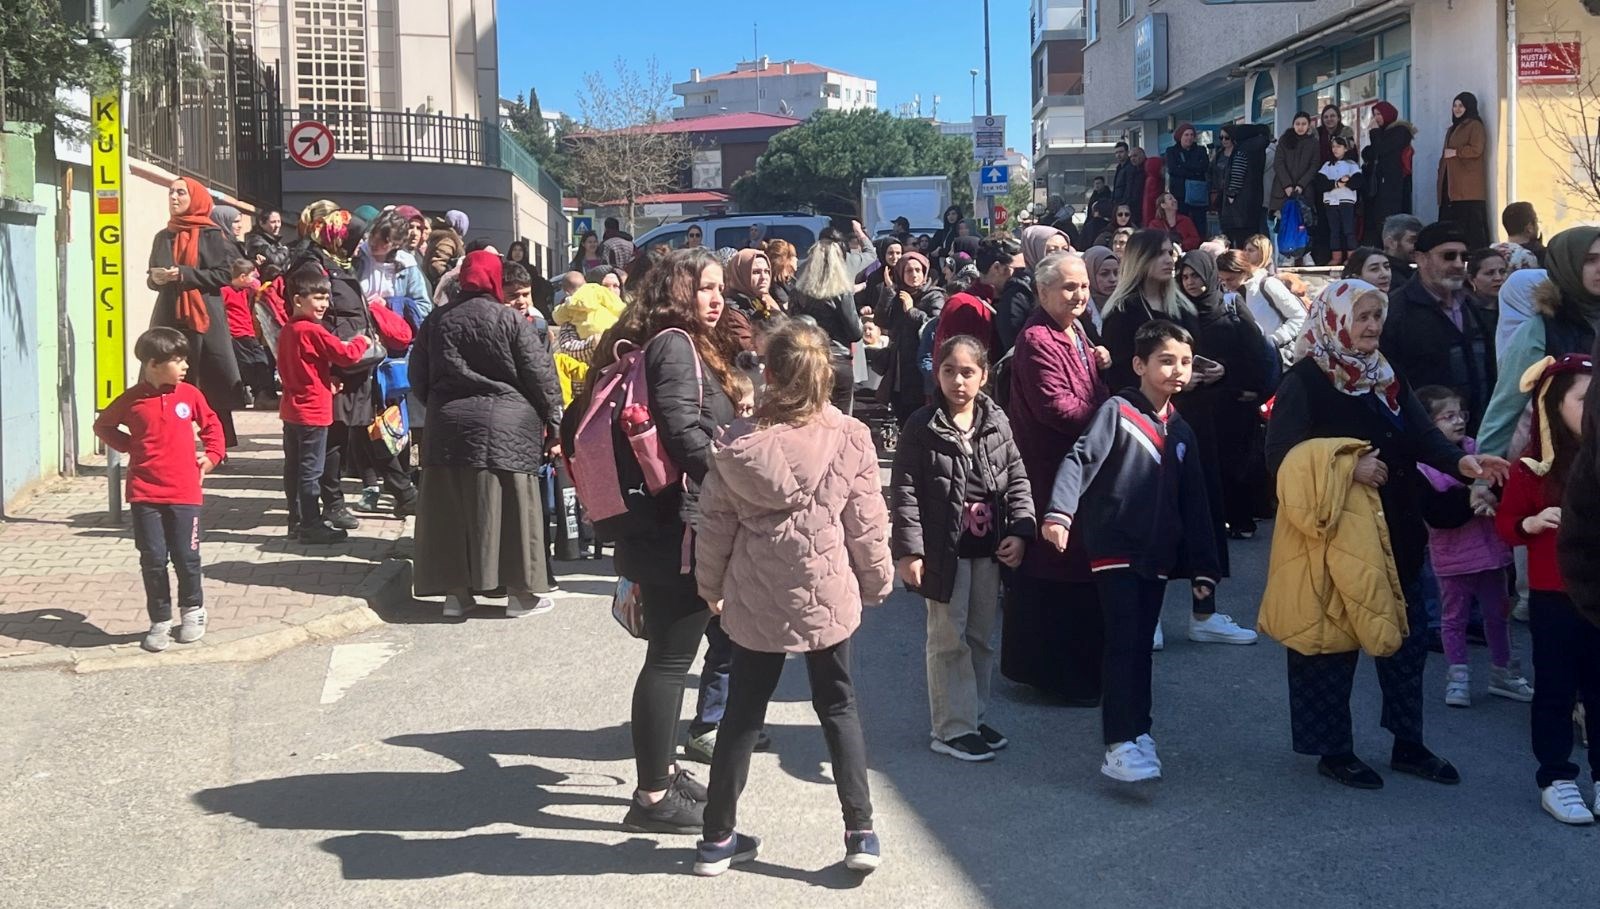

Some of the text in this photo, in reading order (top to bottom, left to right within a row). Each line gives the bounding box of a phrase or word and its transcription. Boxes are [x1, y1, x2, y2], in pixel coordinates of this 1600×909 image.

[1521, 53, 1552, 61] MUSTAFA
[1521, 60, 1547, 68] KARTAL
[97, 102, 116, 184] KUL
[995, 210, 1007, 220] UR
